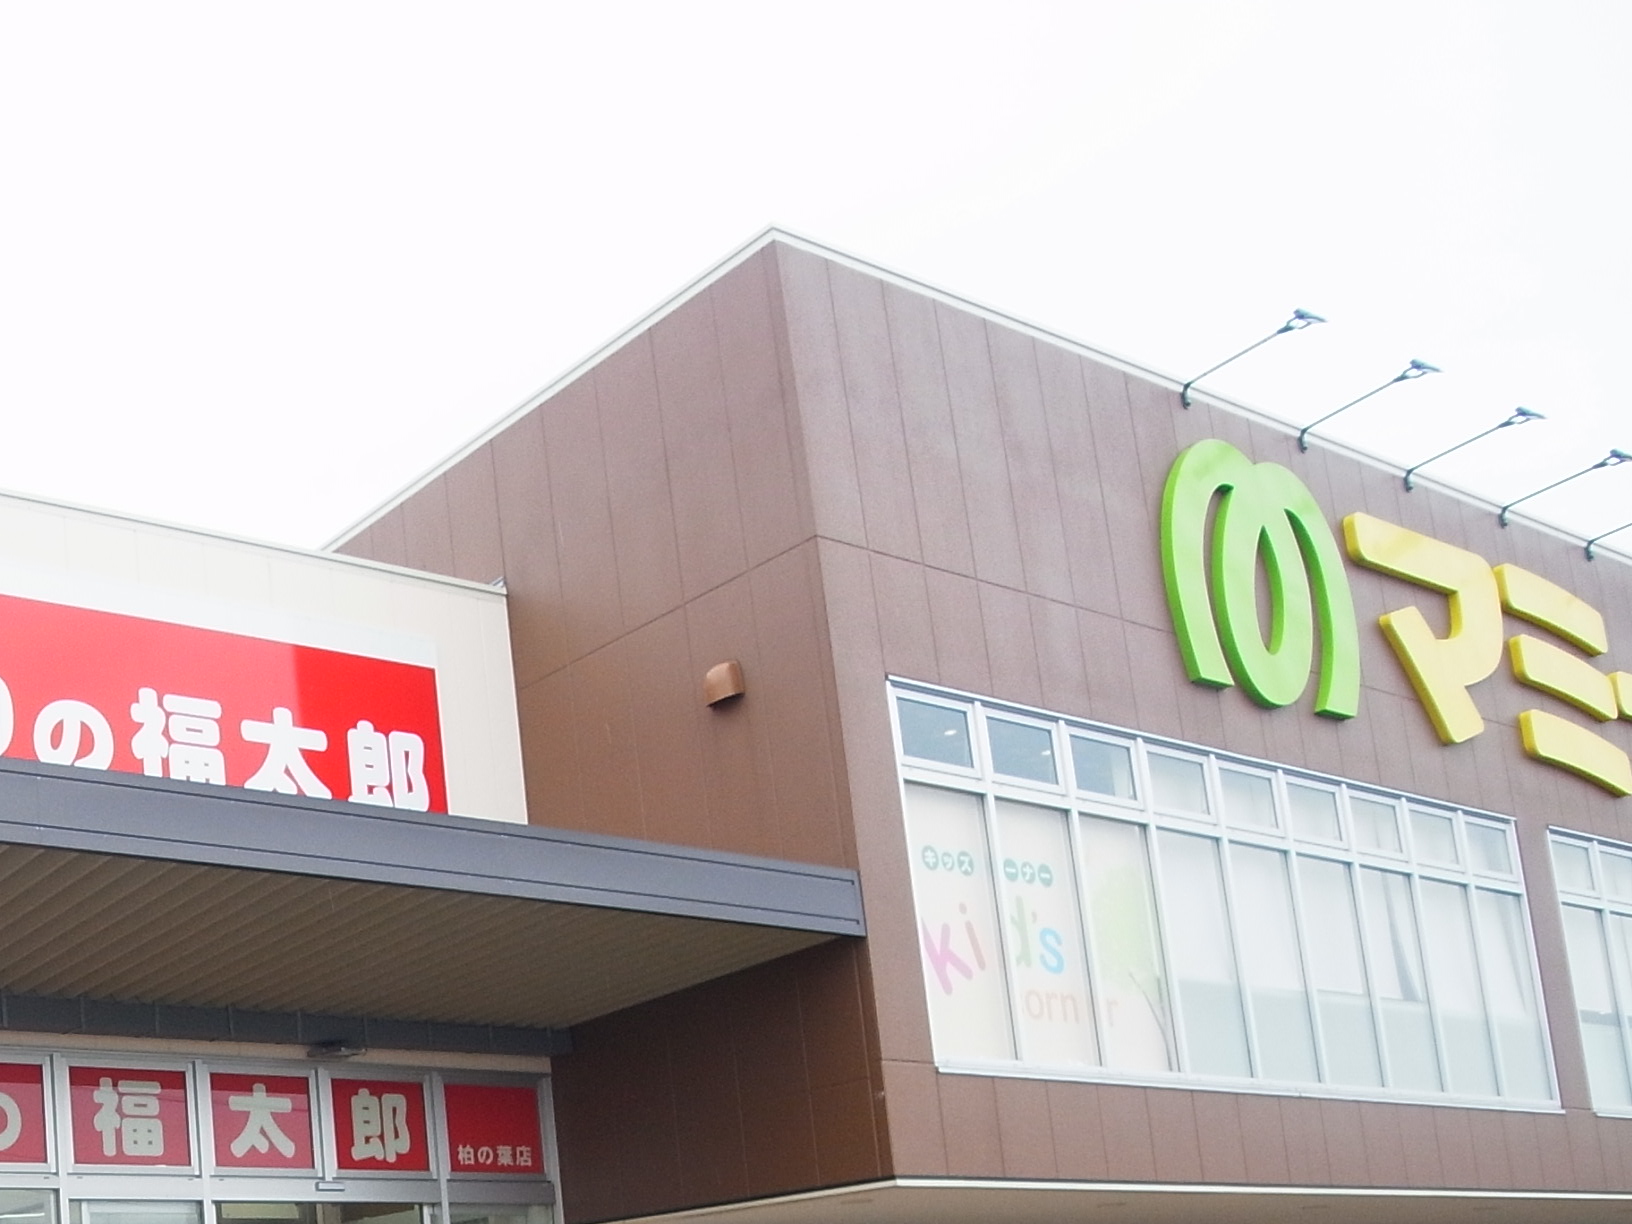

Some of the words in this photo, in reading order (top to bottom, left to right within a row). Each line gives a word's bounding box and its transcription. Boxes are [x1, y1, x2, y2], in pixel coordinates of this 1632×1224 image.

[1342, 511, 1632, 797] マミ
[458, 1144, 533, 1166] 柏の葉店
